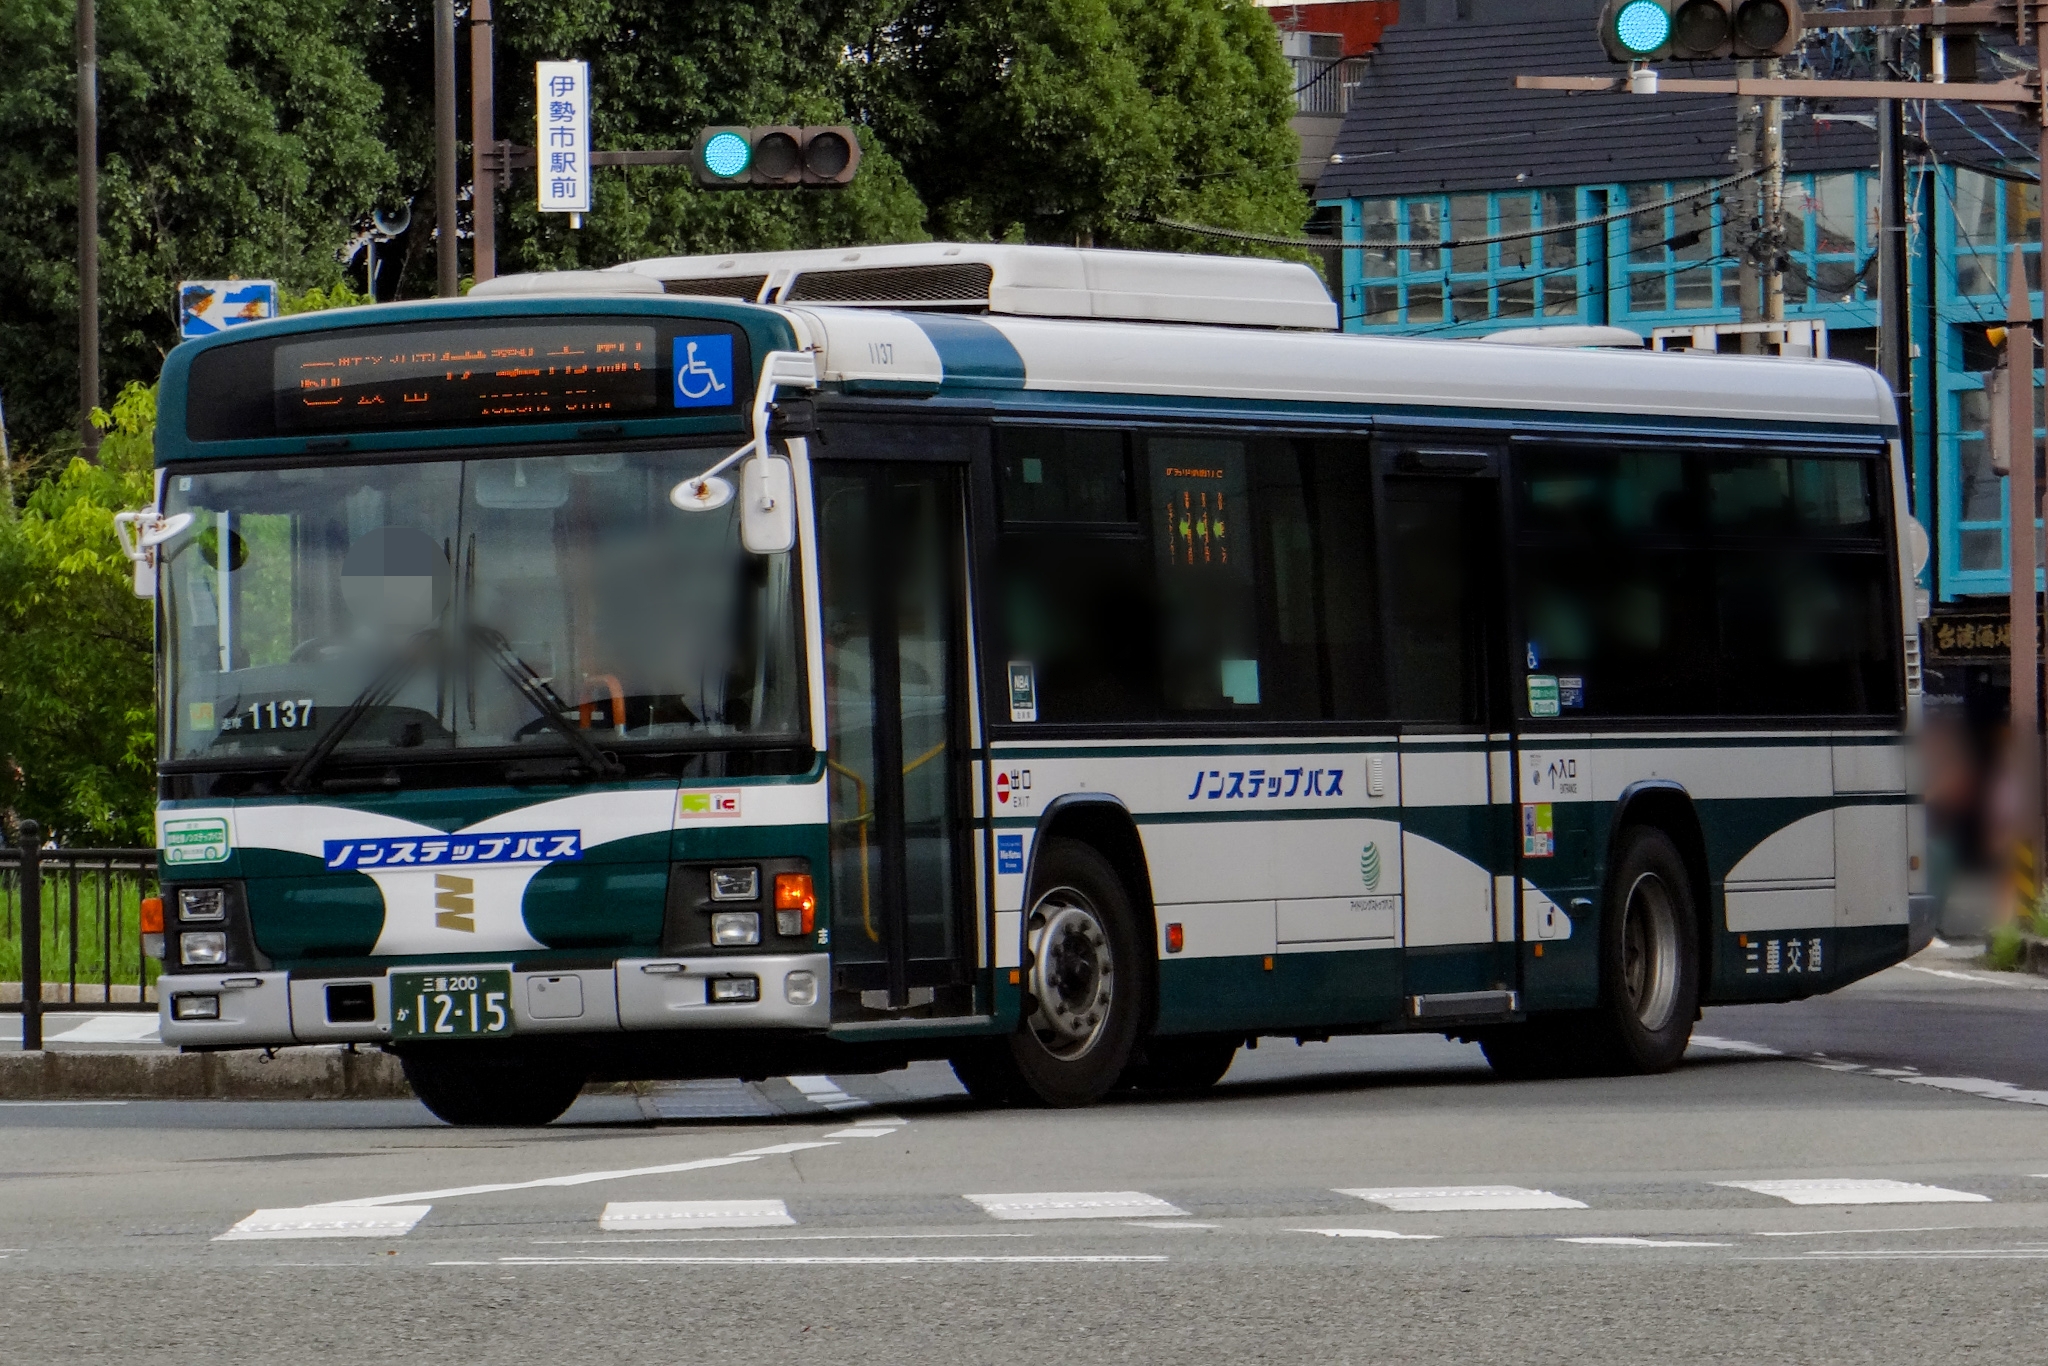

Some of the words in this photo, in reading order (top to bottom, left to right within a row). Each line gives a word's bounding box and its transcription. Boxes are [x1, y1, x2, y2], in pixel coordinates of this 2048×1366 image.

[548, 75, 577, 199] 伊勢市駅前
[868, 342, 893, 365] 1137
[1937, 623, 2040, 649] 台湾酒場
[1014, 674, 1030, 689] NBA
[249, 699, 313, 729] 1137
[1010, 769, 1031, 790] 出口
[1559, 759, 1576, 778] 入口
[1188, 767, 1344, 800] ノンステップバス
[1013, 795, 1030, 808] EXIT
[328, 835, 578, 868] ノンステップバス
[1746, 937, 1822, 974] 三重交通
[422, 976, 478, 992] 三重200
[396, 1008, 410, 1021] か
[417, 992, 506, 1034] 12-15
